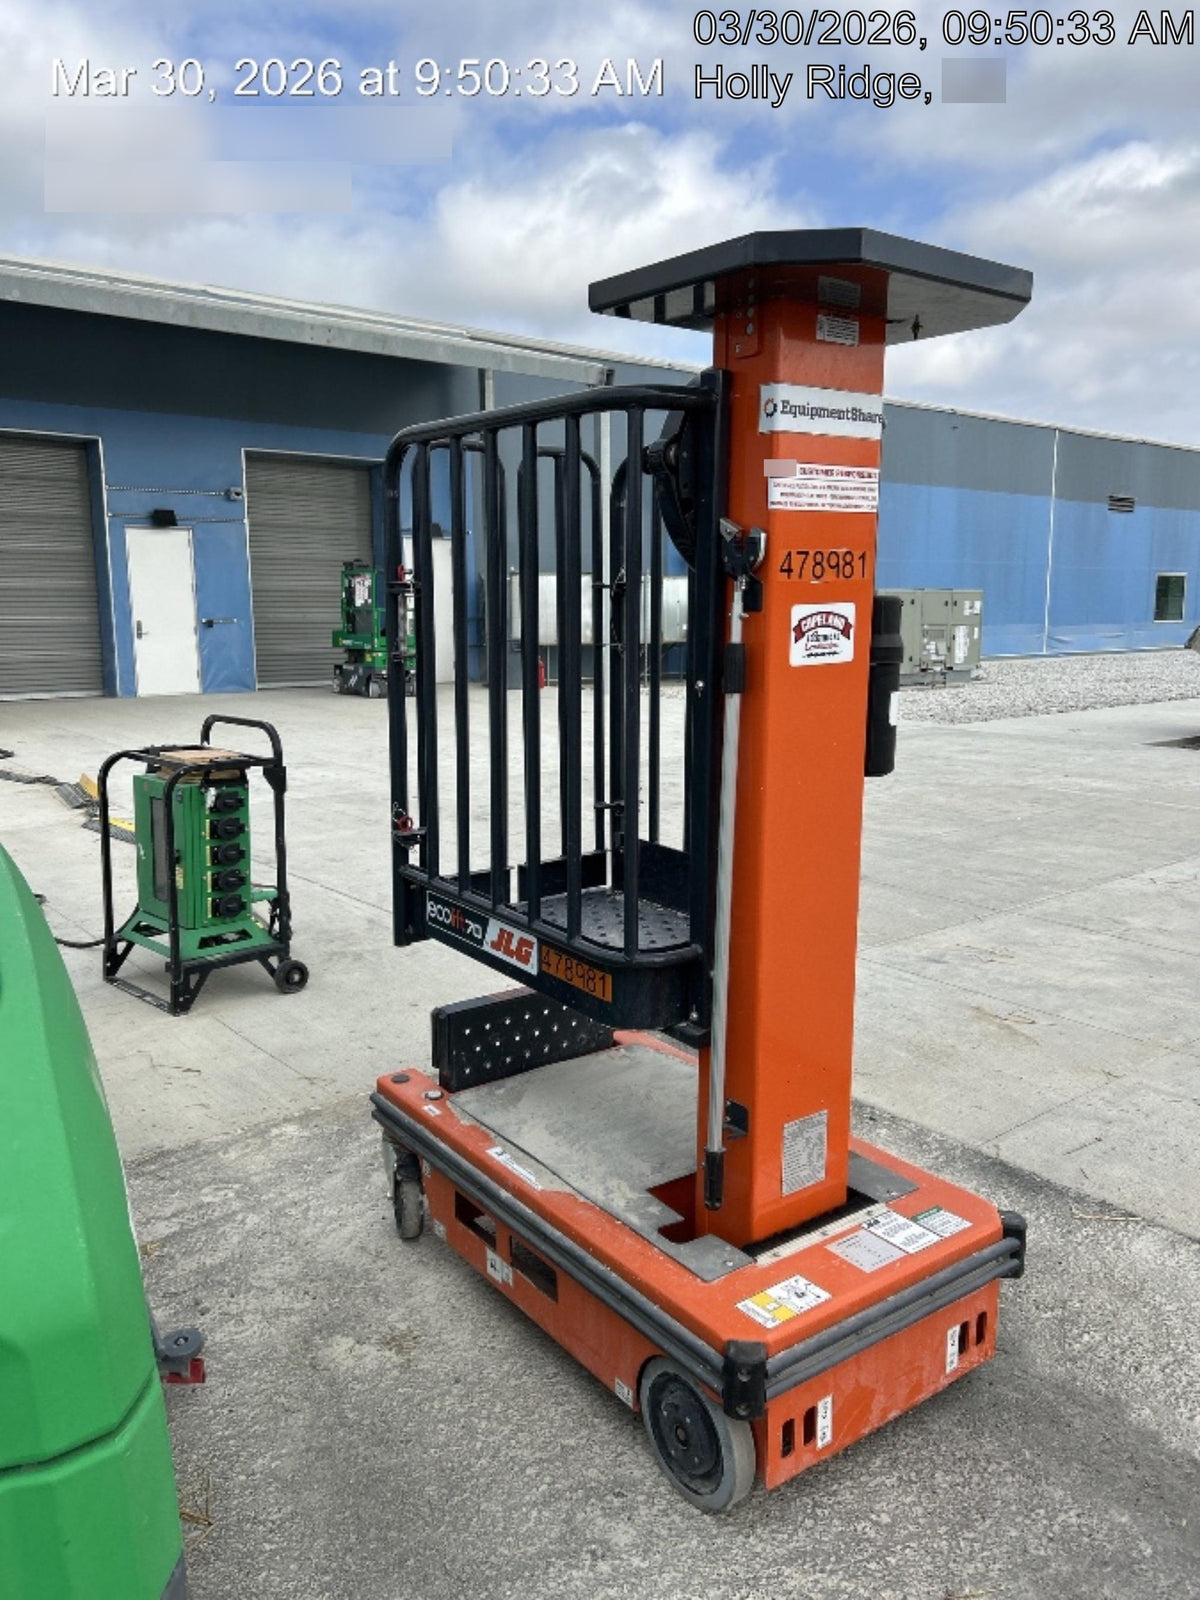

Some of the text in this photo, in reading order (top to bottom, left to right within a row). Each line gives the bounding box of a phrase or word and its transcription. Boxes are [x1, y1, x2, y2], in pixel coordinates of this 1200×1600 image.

[780, 550, 867, 580] 478981
[490, 927, 536, 966] JLG
[541, 946, 607, 999] 478981
